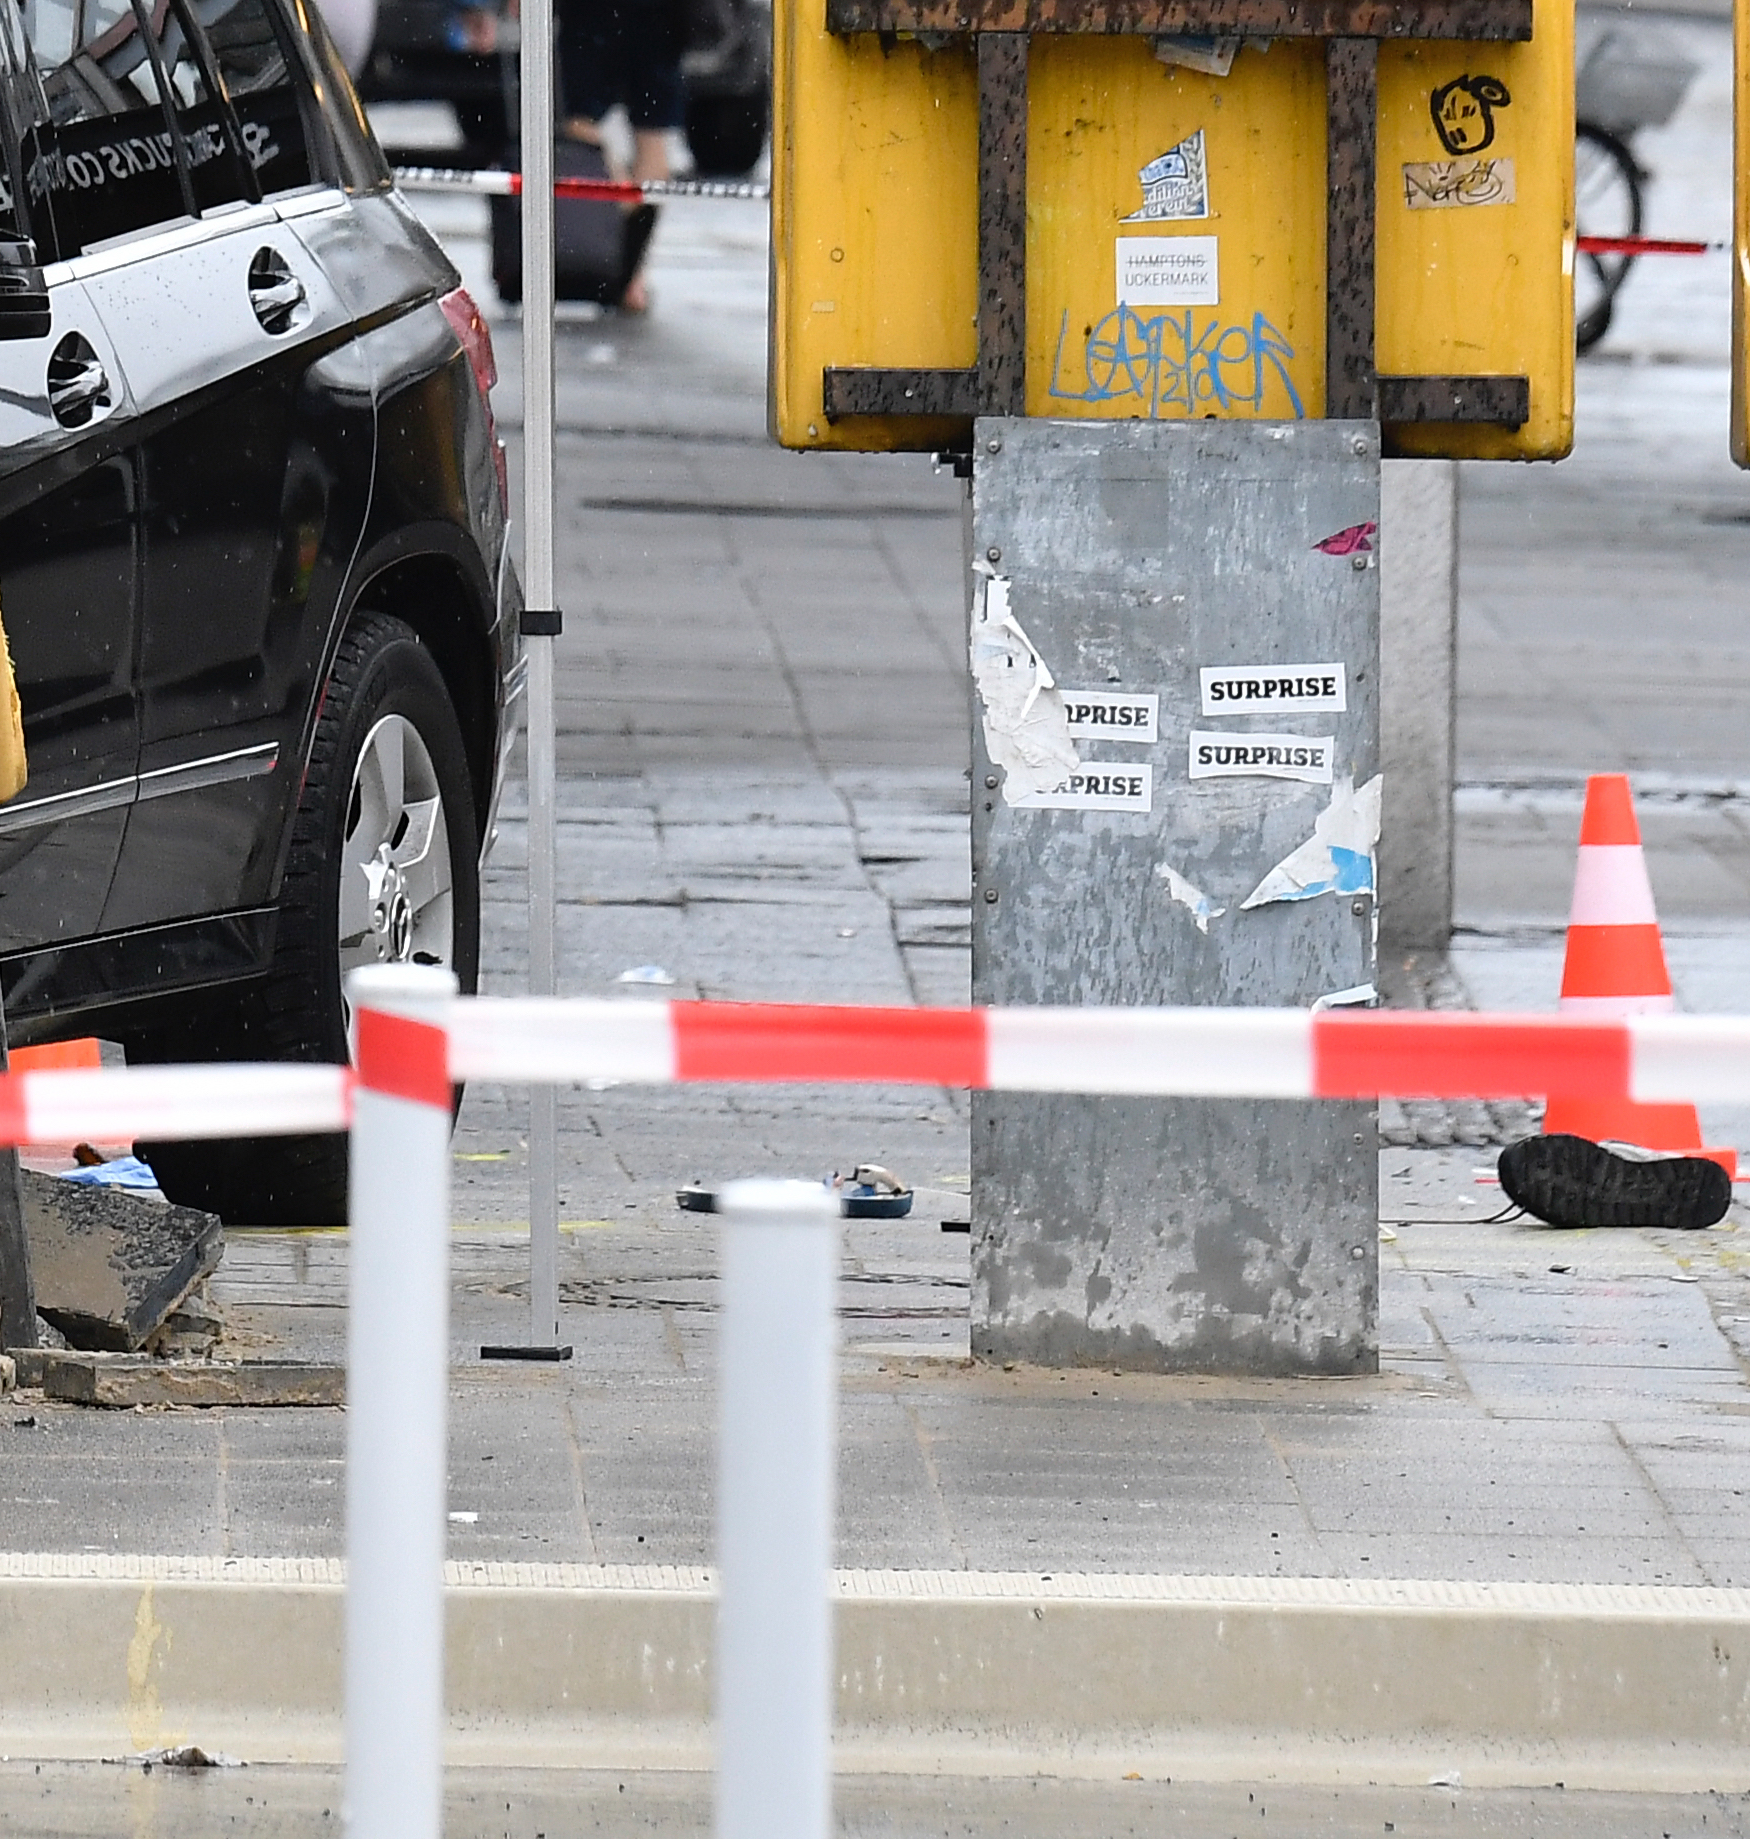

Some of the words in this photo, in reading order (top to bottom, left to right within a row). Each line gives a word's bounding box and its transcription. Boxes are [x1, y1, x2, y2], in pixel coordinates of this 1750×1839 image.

[1125, 271, 1209, 287] UCKERMARK
[1210, 676, 1337, 701] SURPRISE
[1198, 745, 1325, 768] SURPRISE
